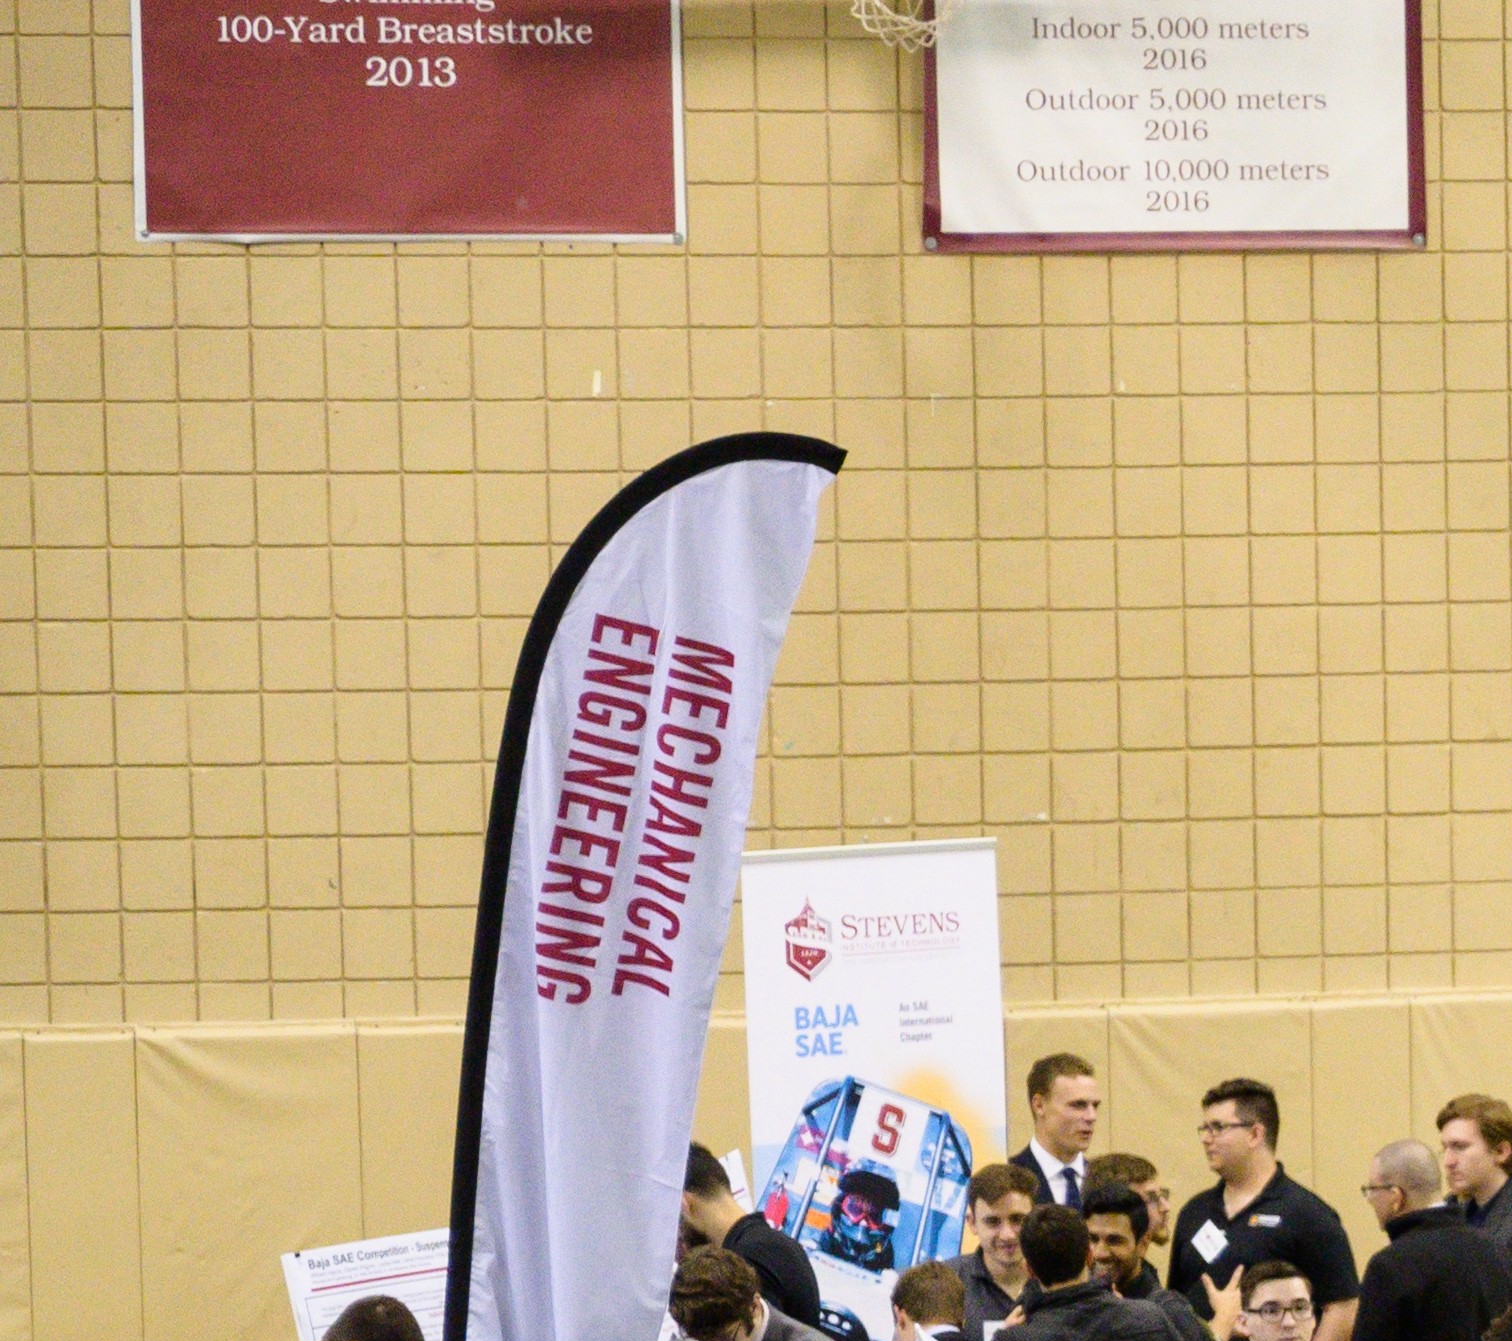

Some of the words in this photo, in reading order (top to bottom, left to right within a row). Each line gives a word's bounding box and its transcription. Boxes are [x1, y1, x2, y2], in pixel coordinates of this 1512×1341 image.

[218, 15, 366, 43] 100-Yard
[377, 17, 592, 44] Breaststroke
[1032, 17, 1121, 39] Indoor
[1132, 17, 1208, 40] 5,000
[1220, 22, 1309, 38] meters
[366, 57, 457, 87] 2013
[1144, 49, 1206, 70] 2016
[1026, 88, 1138, 110] Outdoor
[1150, 89, 1226, 111] 5,000
[1237, 92, 1326, 110] meters
[1145, 120, 1208, 141] 2016
[1017, 159, 1129, 181] Outdoor
[1146, 160, 1229, 181] 10,000
[1240, 161, 1329, 180] meters
[1147, 191, 1209, 212] 2016
[537, 615, 659, 1005] ENGINEERING
[612, 636, 736, 998] MECHANICAL
[841, 912, 960, 939] STEVENS
[795, 1004, 858, 1029] BAJA
[795, 1032, 843, 1057] SAE
[871, 1103, 905, 1154] S
[307, 1259, 330, 1270] Baja
[332, 1252, 354, 1265] SAE
[357, 1246, 408, 1261] Competition
